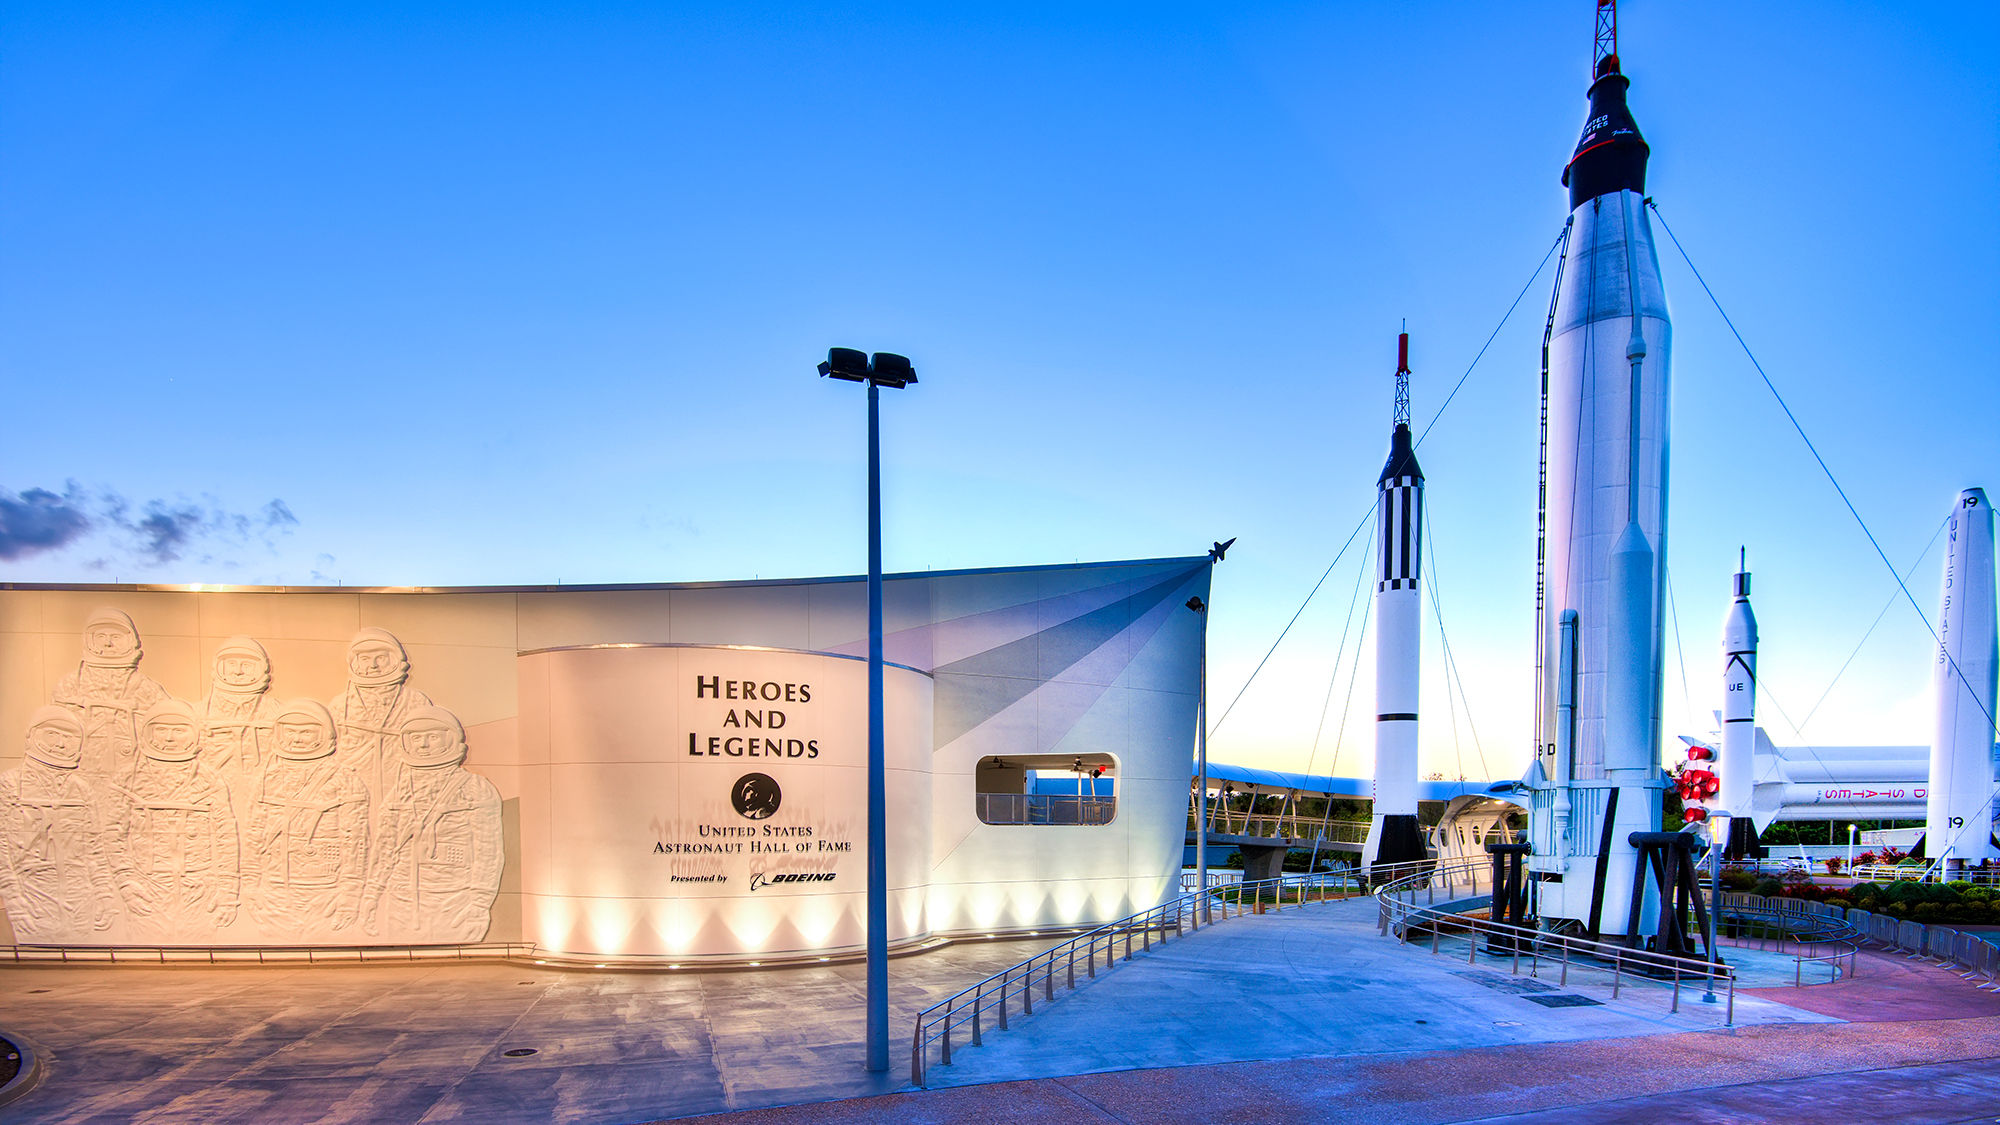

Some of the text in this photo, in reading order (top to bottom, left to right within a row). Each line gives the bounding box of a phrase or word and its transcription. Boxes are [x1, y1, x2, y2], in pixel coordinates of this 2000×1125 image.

[1962, 496, 1978, 509] 19
[1946, 519, 1958, 589] UNITED
[696, 675, 811, 703] HEROES
[1728, 682, 1744, 692] UE
[723, 708, 786, 729] AND
[688, 732, 819, 759] LEGENDS
[1948, 816, 1964, 829] 19
[699, 824, 813, 838] UNITED STATES
[653, 840, 852, 854] ASTRONAUT HALL OF FAME
[670, 874, 728, 884] Presented by
[771, 872, 837, 884] BOEING
